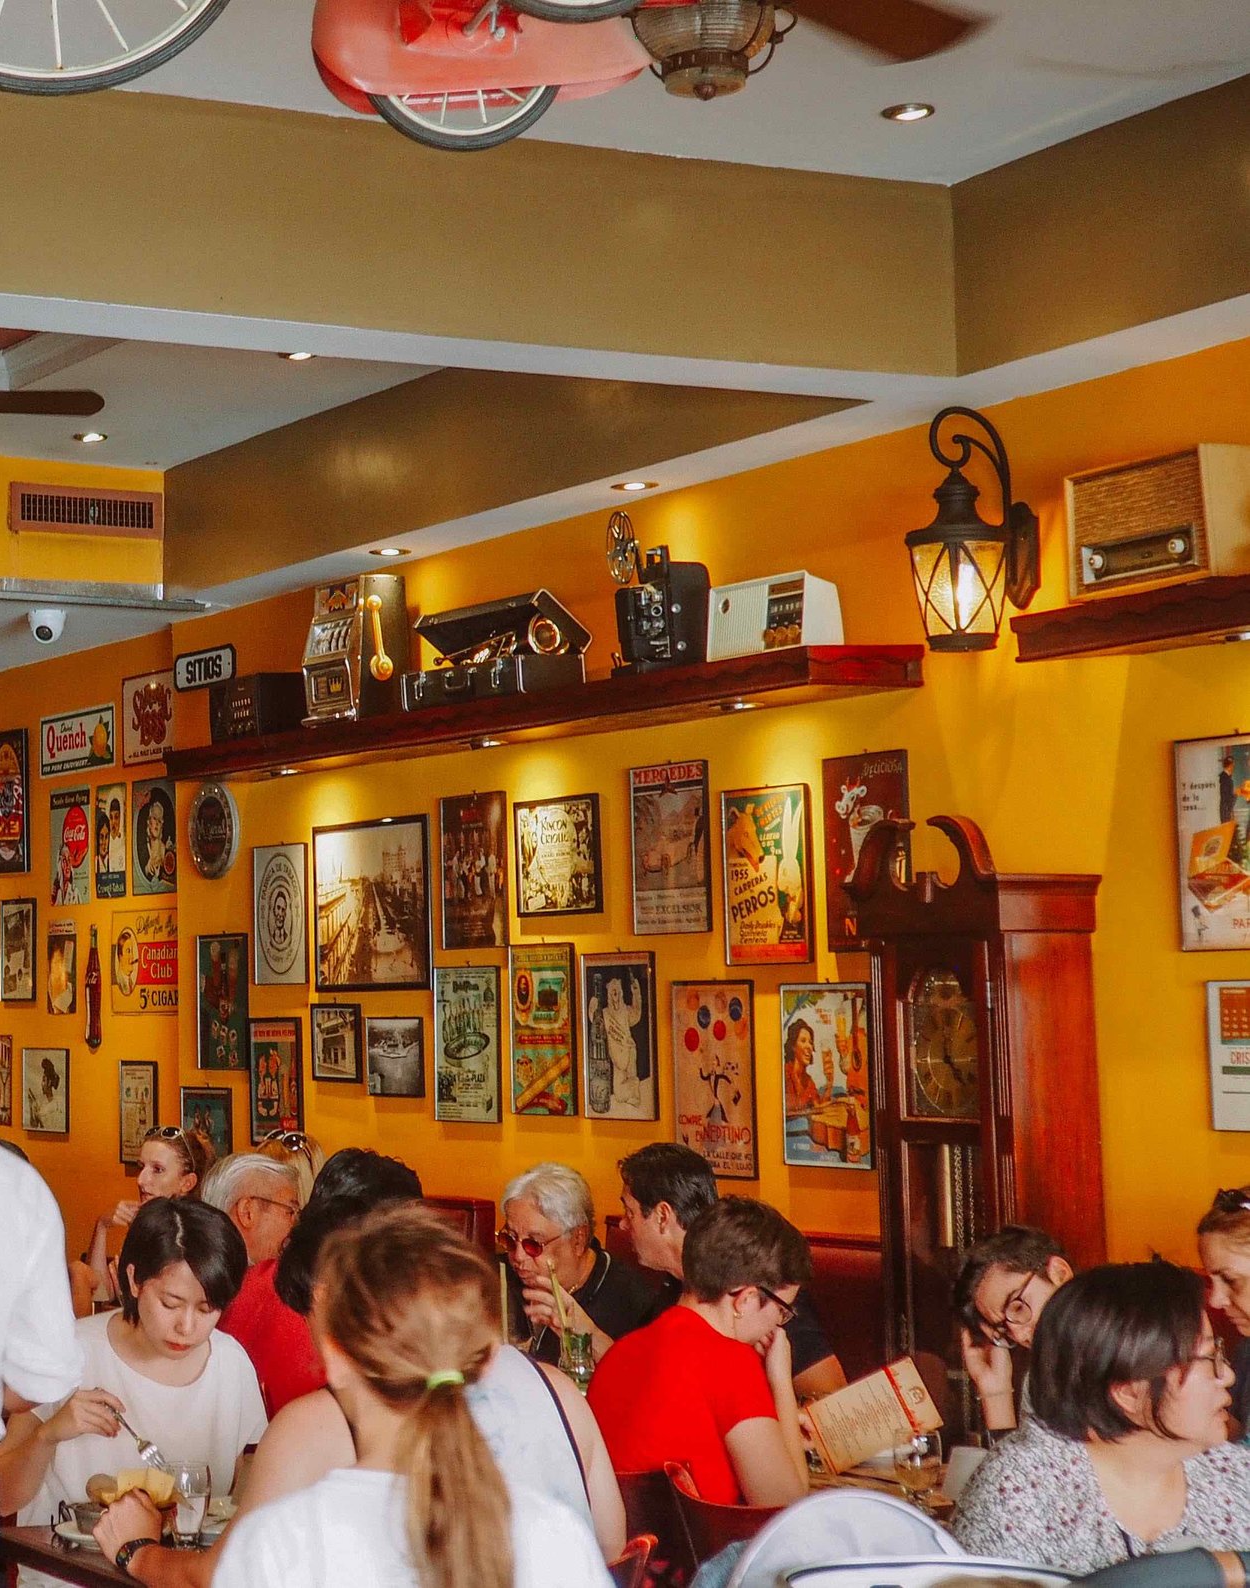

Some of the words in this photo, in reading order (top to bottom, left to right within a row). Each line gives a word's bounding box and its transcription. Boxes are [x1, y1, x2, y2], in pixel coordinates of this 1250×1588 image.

[185, 654, 223, 685] SITIOS
[60, 718, 74, 733] Drink
[46, 722, 87, 758] Quench
[731, 868, 749, 882] 1955
[734, 872, 768, 897] CARRERAS
[731, 886, 776, 923] PERROS
[150, 962, 173, 979] Club
[703, 1123, 751, 1145] NEPTUNO
